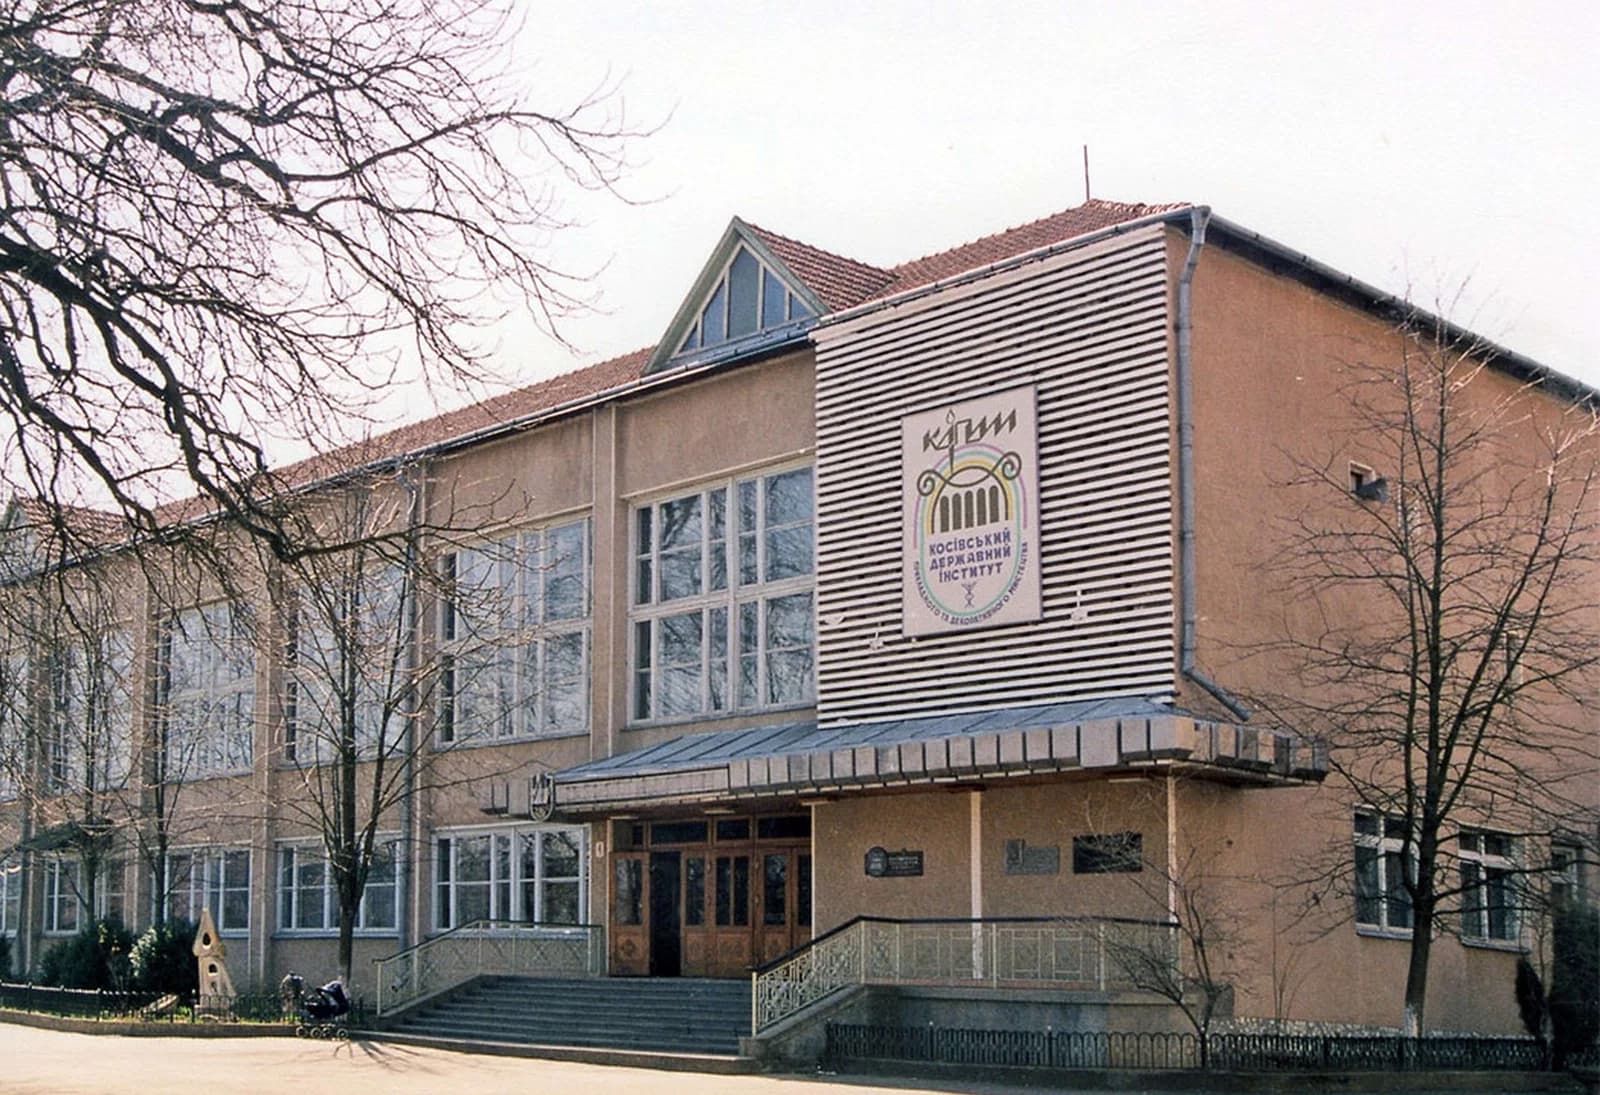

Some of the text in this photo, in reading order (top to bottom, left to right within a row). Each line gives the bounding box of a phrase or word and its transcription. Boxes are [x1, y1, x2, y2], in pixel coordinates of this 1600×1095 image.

[929, 527, 1012, 556] КОСІВСЬКИЙ
[929, 543, 1012, 571] ДЕРЖАВНИЙ
[938, 561, 1004, 583] ІНСТИТУТ
